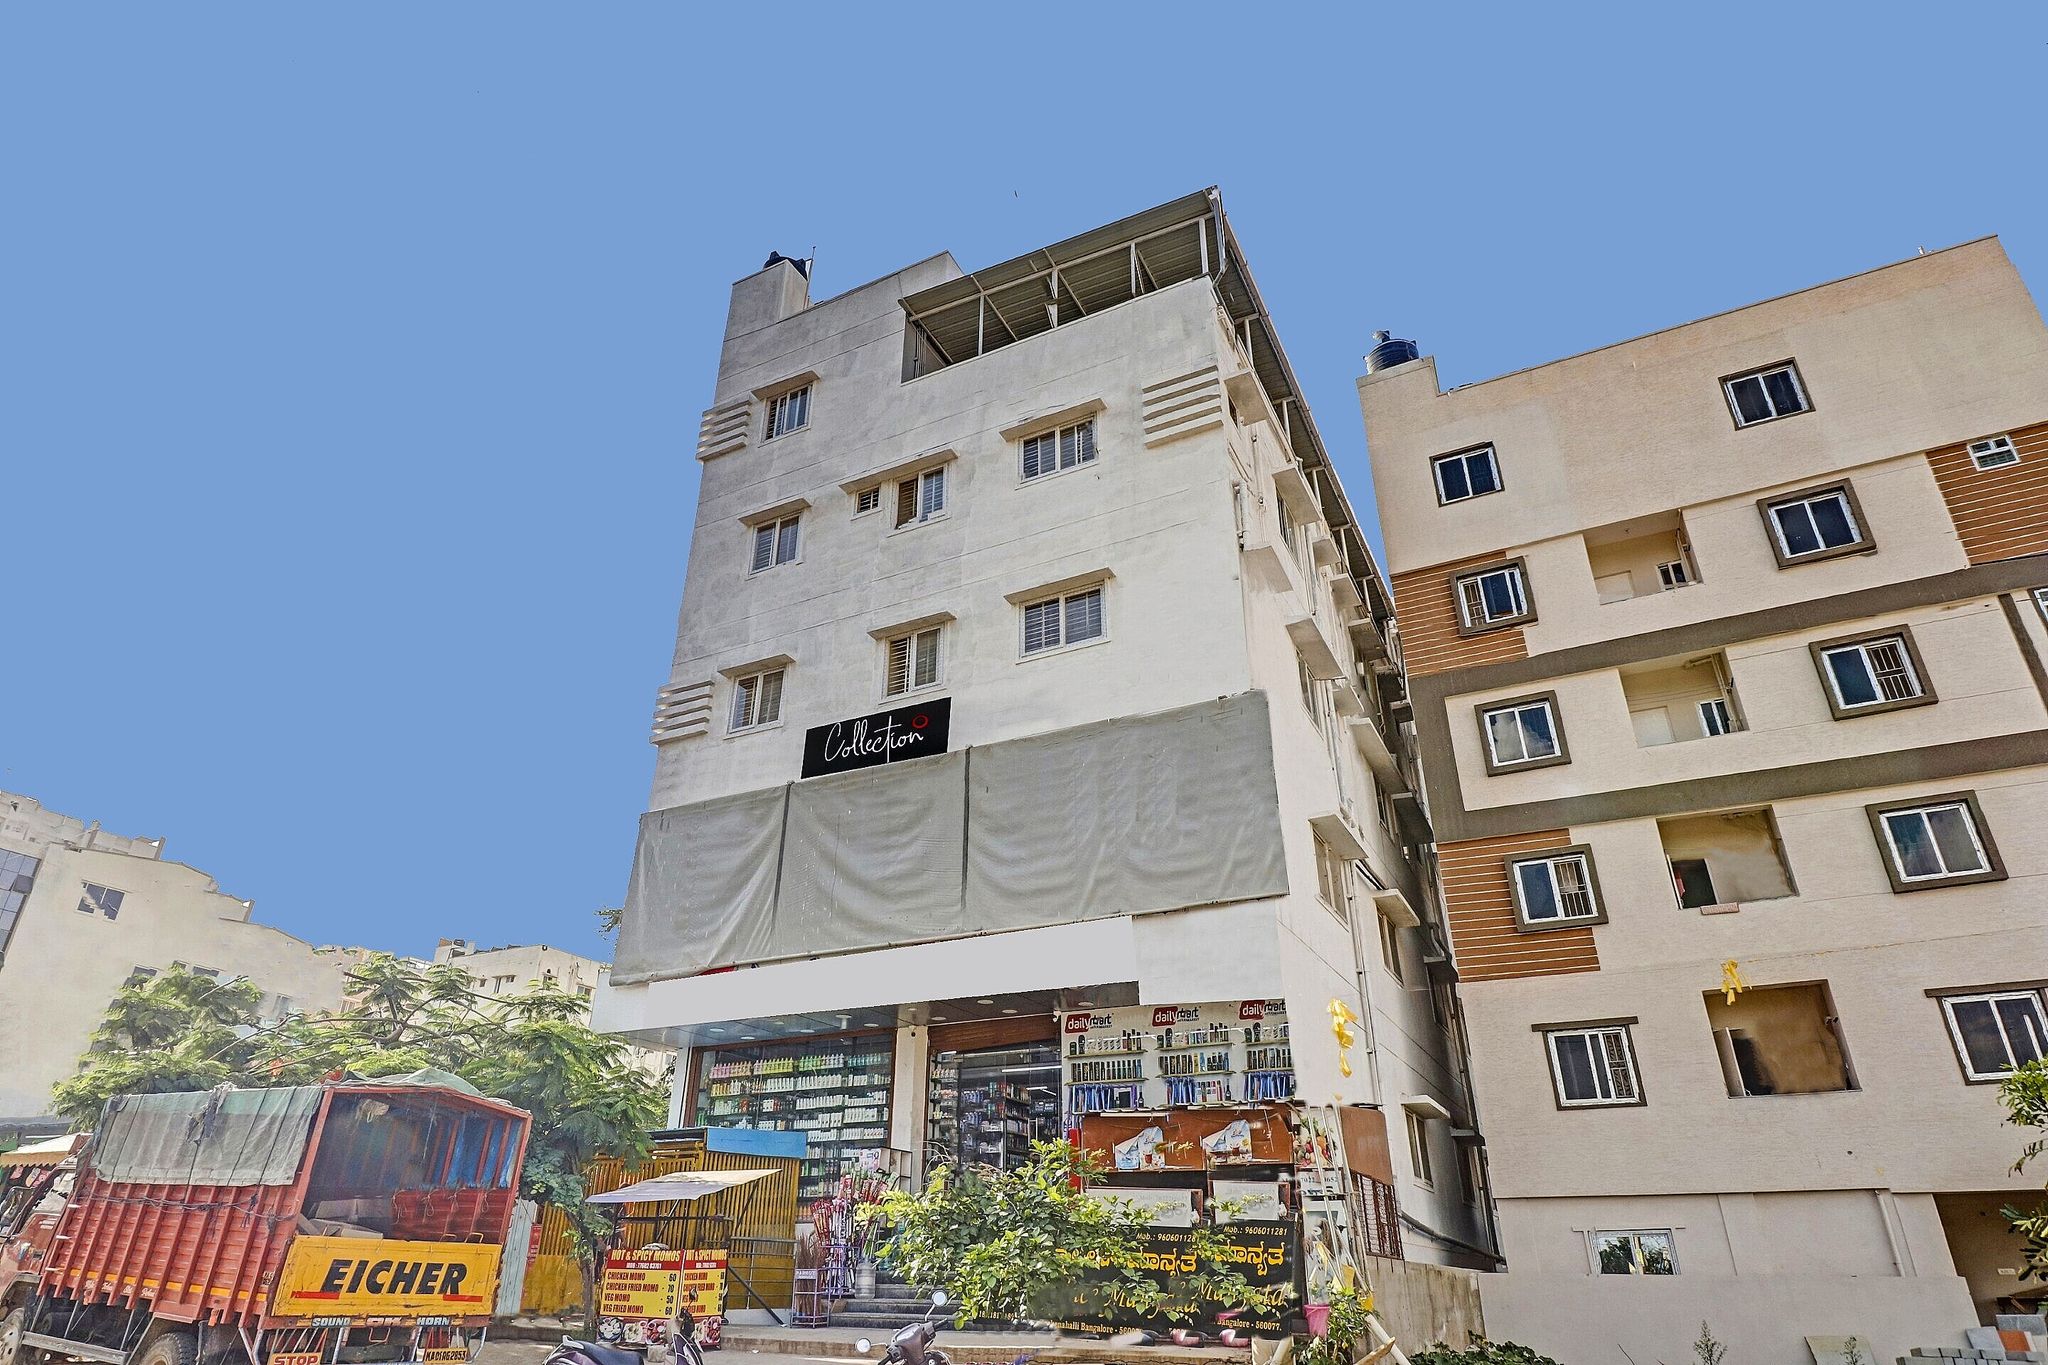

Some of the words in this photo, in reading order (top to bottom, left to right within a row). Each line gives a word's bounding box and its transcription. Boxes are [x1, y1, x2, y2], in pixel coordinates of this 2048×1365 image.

[825, 715, 924, 763] Collection
[1244, 1226, 1288, 1236] 9606011281
[1157, 1233, 1199, 1243] 960601128
[611, 1249, 626, 1260] HOT
[632, 1249, 653, 1261] SPICY
[653, 1250, 681, 1261] MOMOS
[320, 1259, 467, 1295] EICHER
[607, 1271, 629, 1281] CHICKEN
[629, 1272, 646, 1281] MOMO
[668, 1273, 677, 1282] 60
[605, 1282, 628, 1292] CHICKEN
[627, 1283, 642, 1292] FRIED
[641, 1283, 659, 1293] MOMO
[667, 1284, 675, 1293] 70
[604, 1293, 614, 1302] VEG
[614, 1293, 631, 1302] MOMO
[665, 1295, 674, 1304] 50
[603, 1304, 612, 1313] VEG
[612, 1304, 627, 1313] FRIED
[627, 1305, 644, 1314] MOMO
[664, 1306, 673, 1315] 60
[311, 1316, 351, 1327] SOUND
[416, 1316, 450, 1327] HORN
[1080, 1322, 1114, 1334] Bangalore
[273, 1354, 320, 1365] STOP
